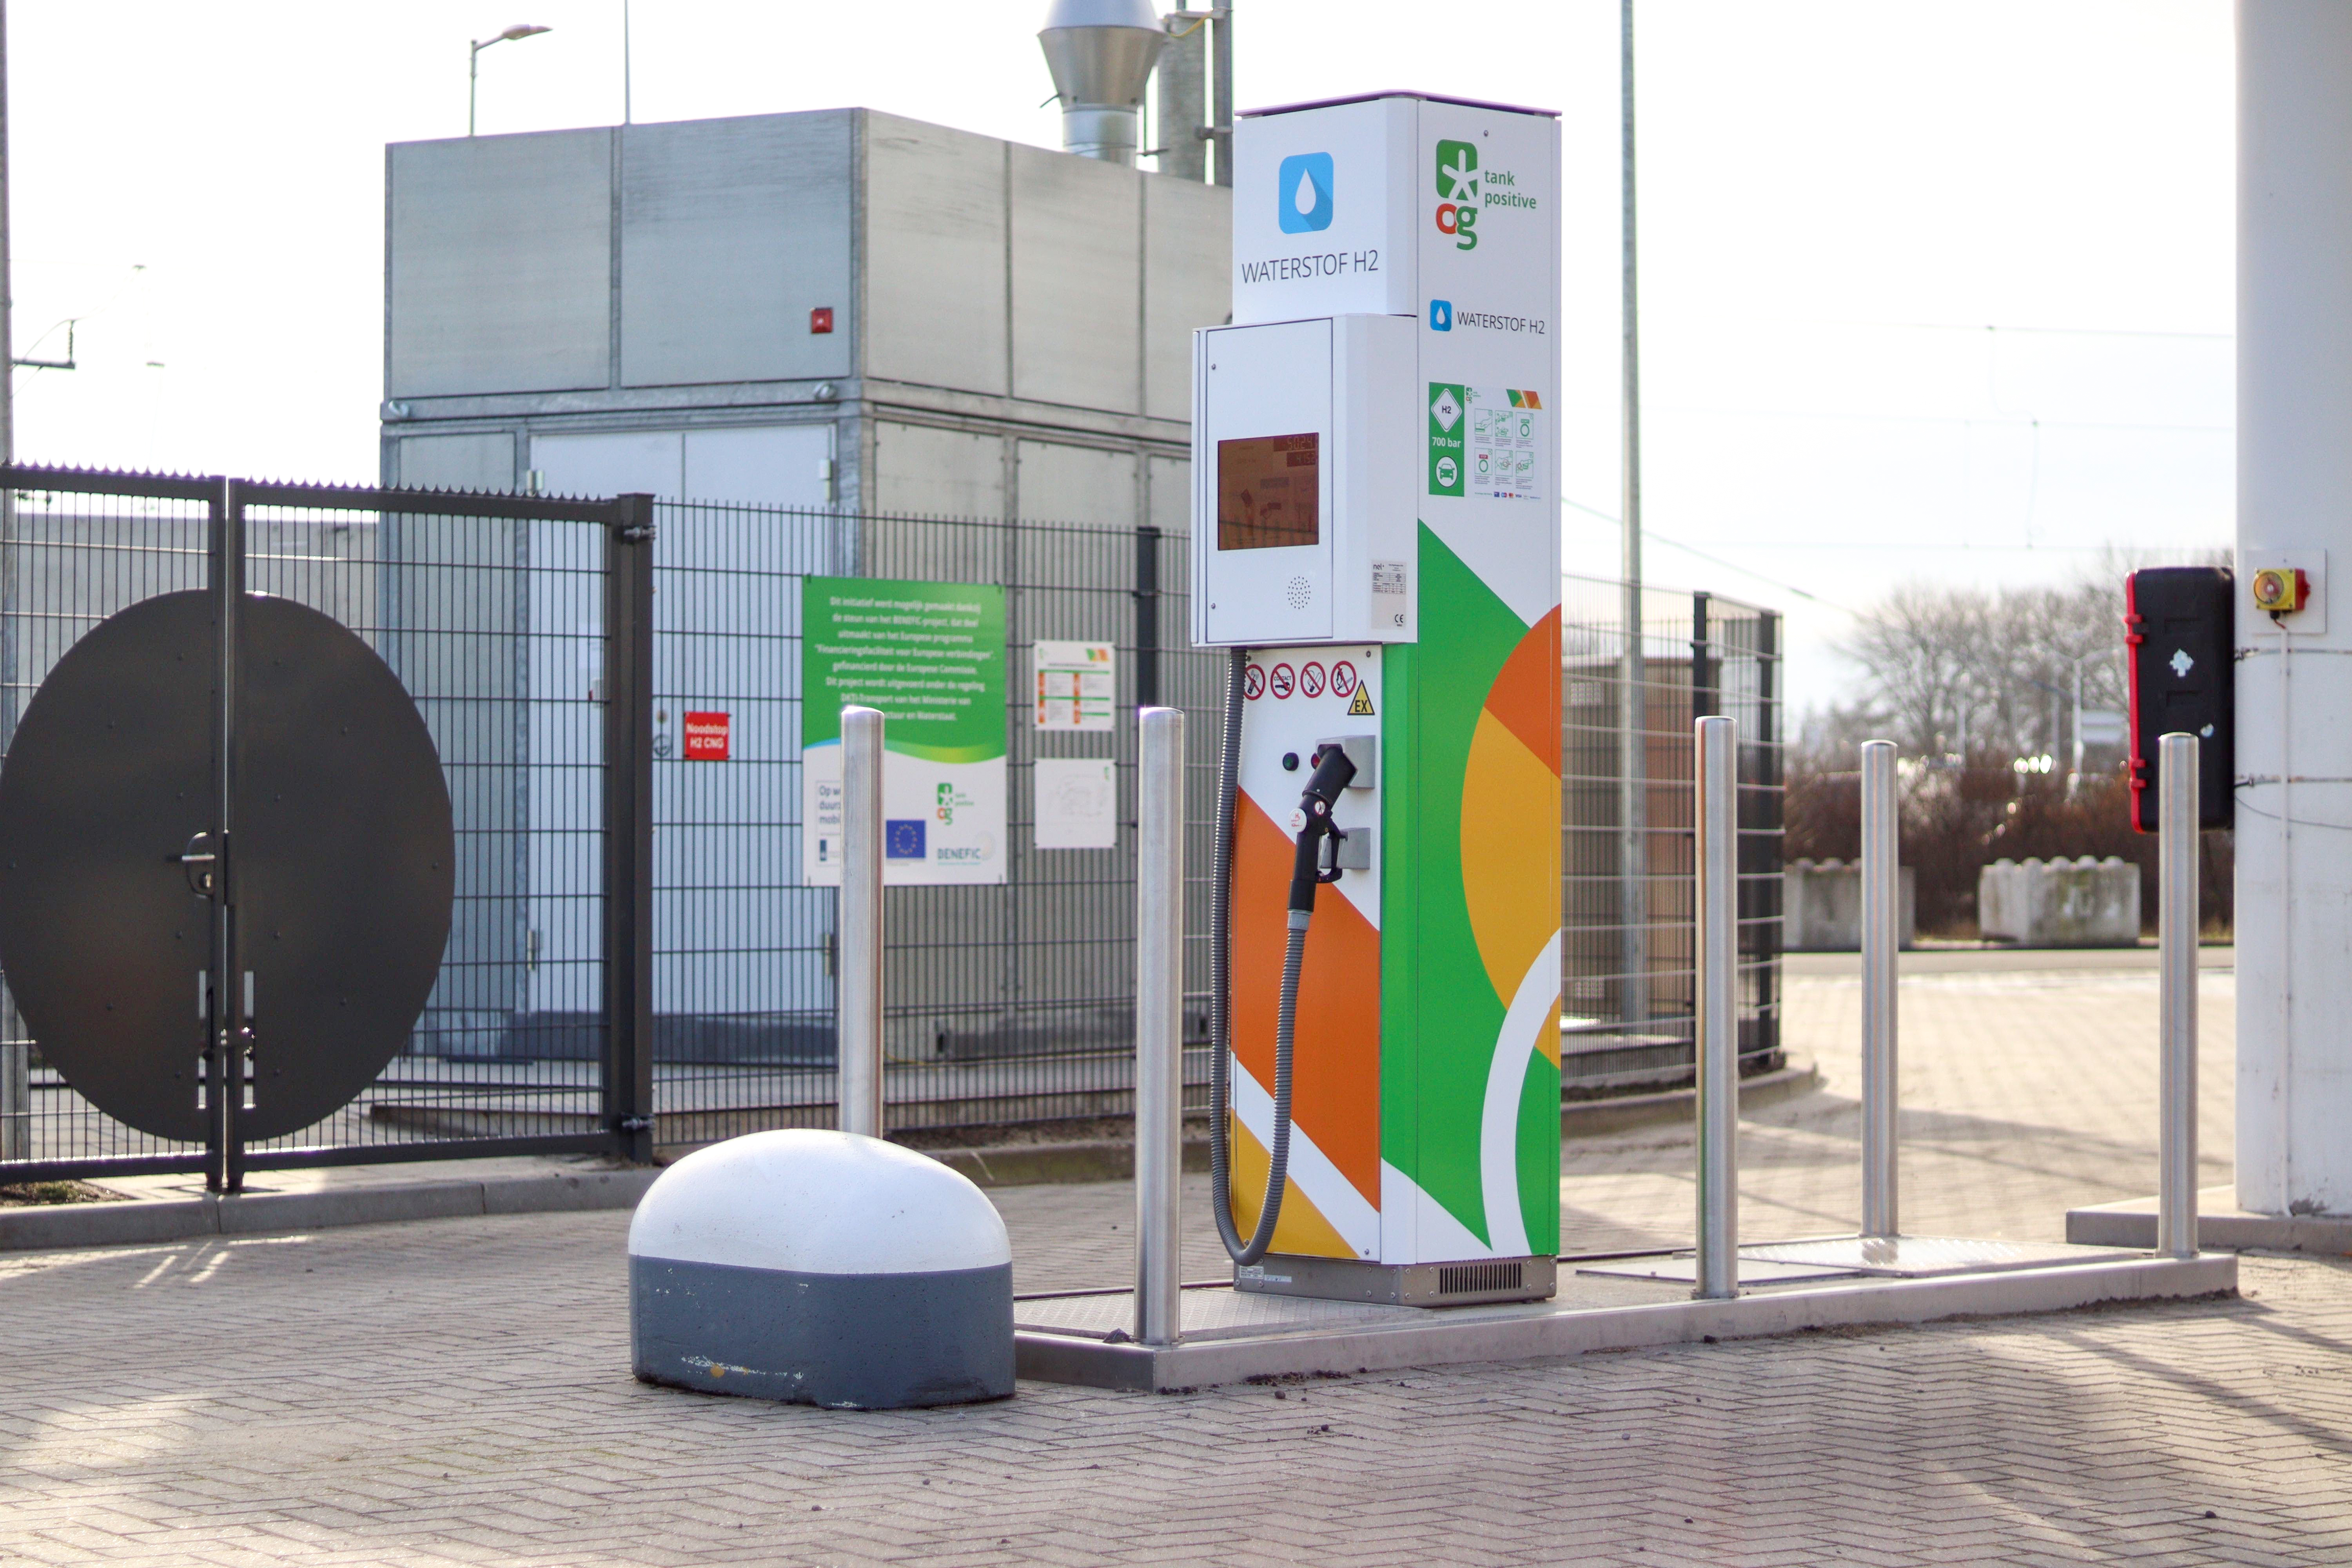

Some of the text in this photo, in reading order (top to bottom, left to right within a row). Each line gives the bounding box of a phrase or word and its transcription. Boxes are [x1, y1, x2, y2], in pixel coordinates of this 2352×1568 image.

[1485, 170, 1515, 186] tank
[1485, 191, 1537, 209] positive
[1241, 250, 1379, 283] WATERSTOF H2
[1457, 311, 1545, 334] WATERSTOF H2
[1442, 405, 1451, 414] H2
[1432, 437, 1461, 447] 700 bar
[1355, 700, 1367, 712] EX
[819, 785, 830, 797] Op
[937, 848, 981, 860] BENEFIC
